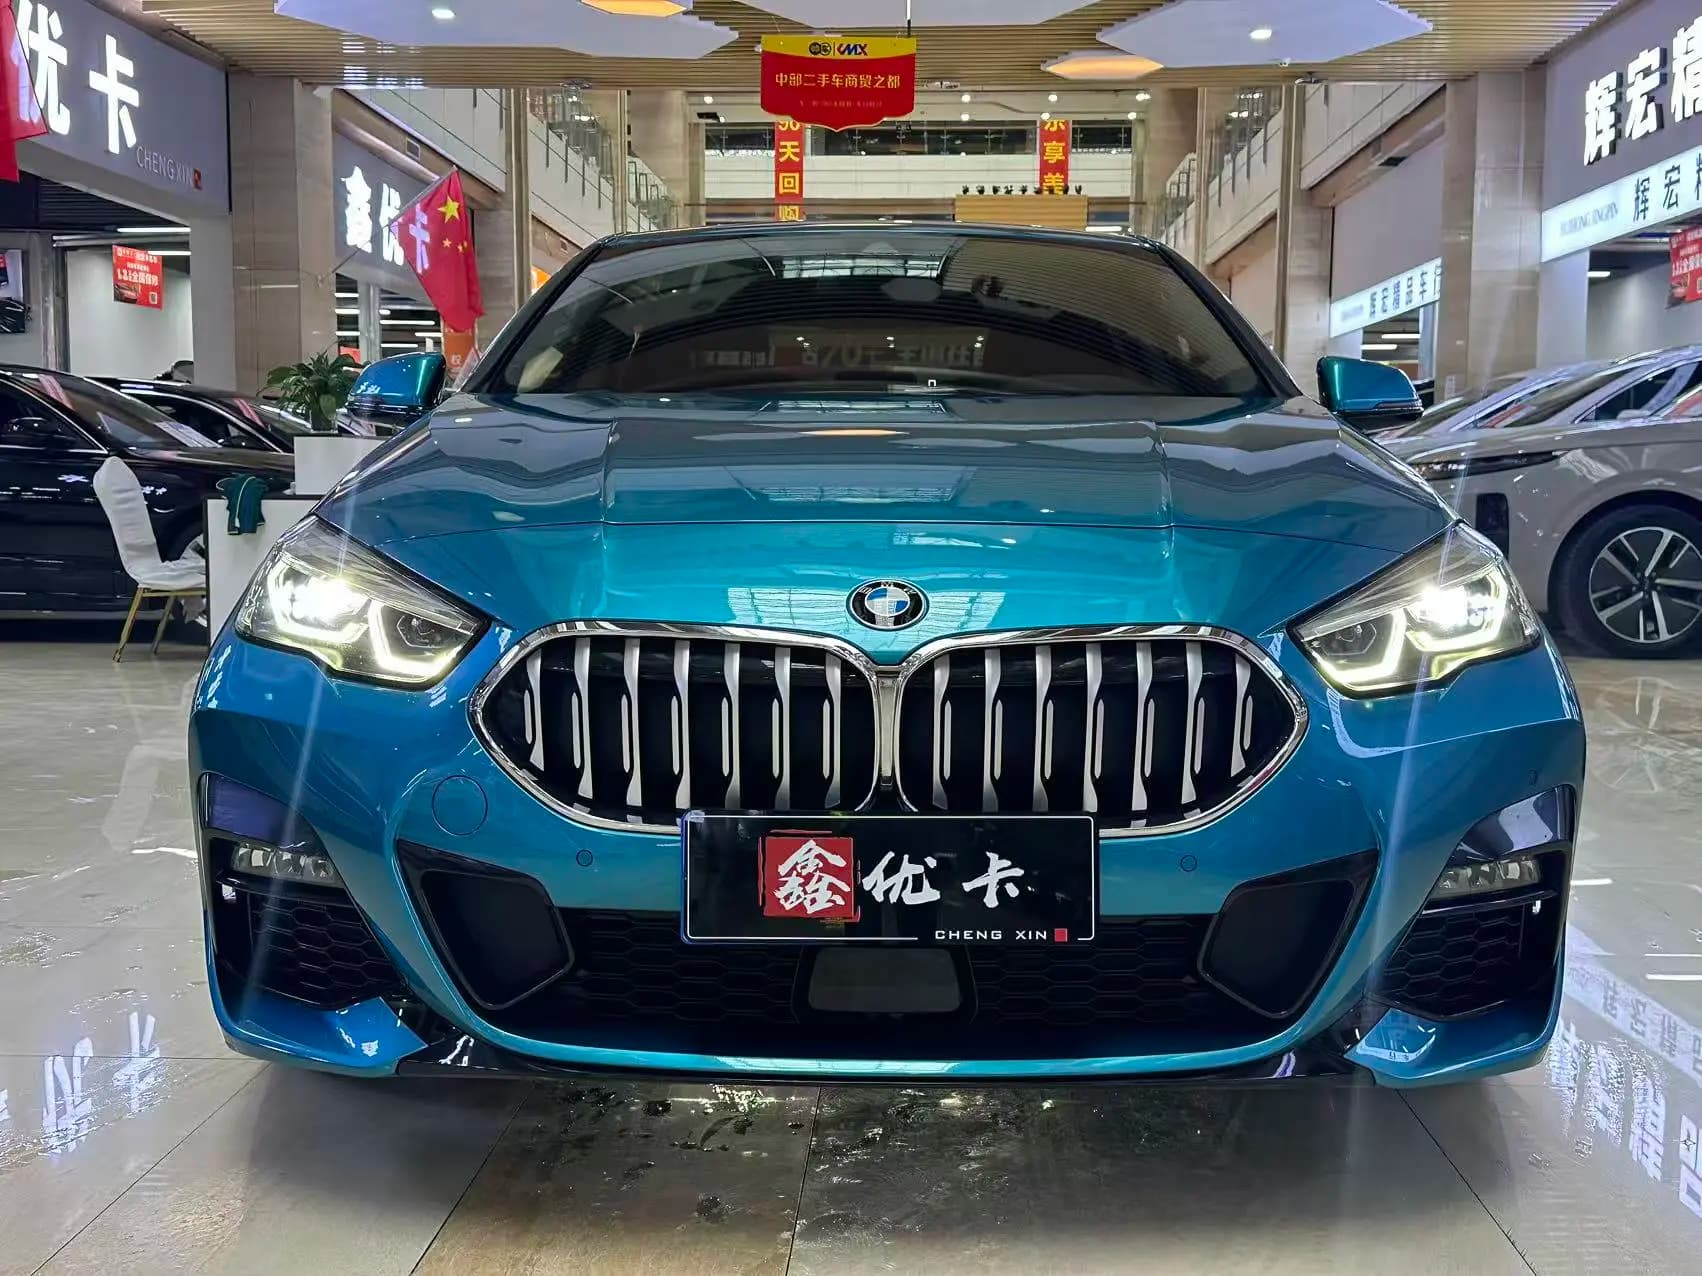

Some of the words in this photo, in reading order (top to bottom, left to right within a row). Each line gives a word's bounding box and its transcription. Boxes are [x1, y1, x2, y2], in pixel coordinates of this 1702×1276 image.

[11, 0, 140, 154] 优卡
[775, 72, 900, 89] 中部二手车商贸之都
[136, 146, 174, 180] CHENG
[935, 928, 1002, 940] CHENG
[1015, 928, 1048, 940] XIN
